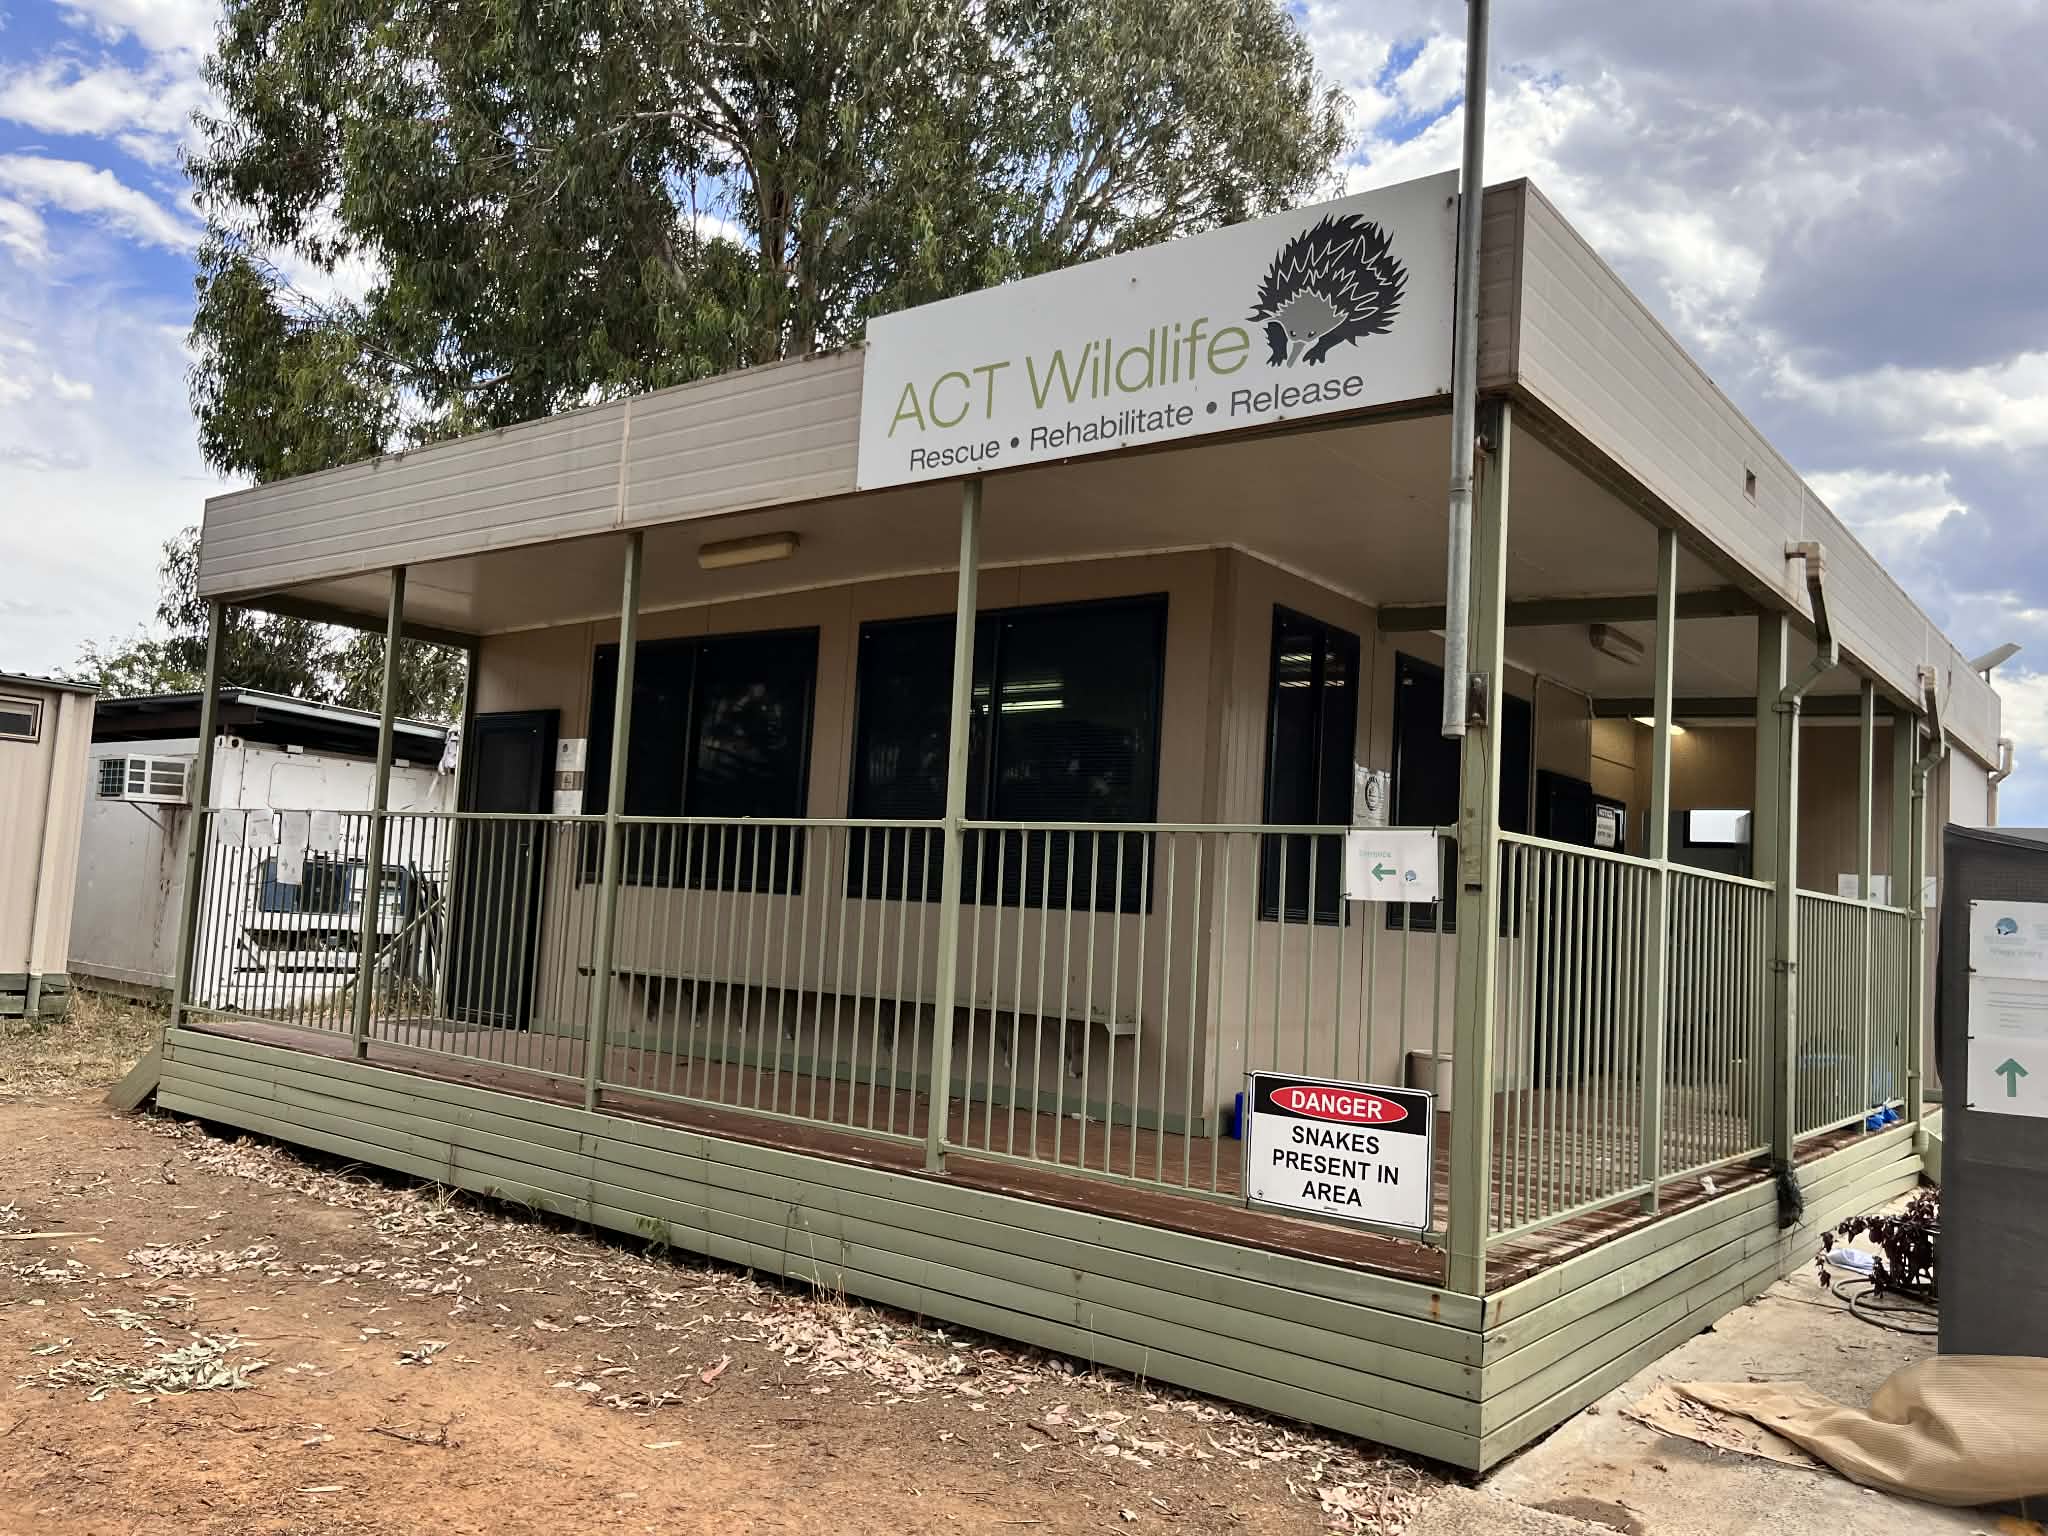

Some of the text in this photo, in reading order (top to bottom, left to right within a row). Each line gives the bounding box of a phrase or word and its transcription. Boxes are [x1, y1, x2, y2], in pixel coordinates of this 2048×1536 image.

[888, 317, 1250, 438] ACT Wildlife
[910, 375, 1364, 471] Rescue Rehabilitate Release
[1291, 1090, 1383, 1120] DANGER
[1292, 1126, 1379, 1154] SNAKES
[1273, 1149, 1399, 1185] PRESENT IN
[1302, 1181, 1362, 1206] AREA
